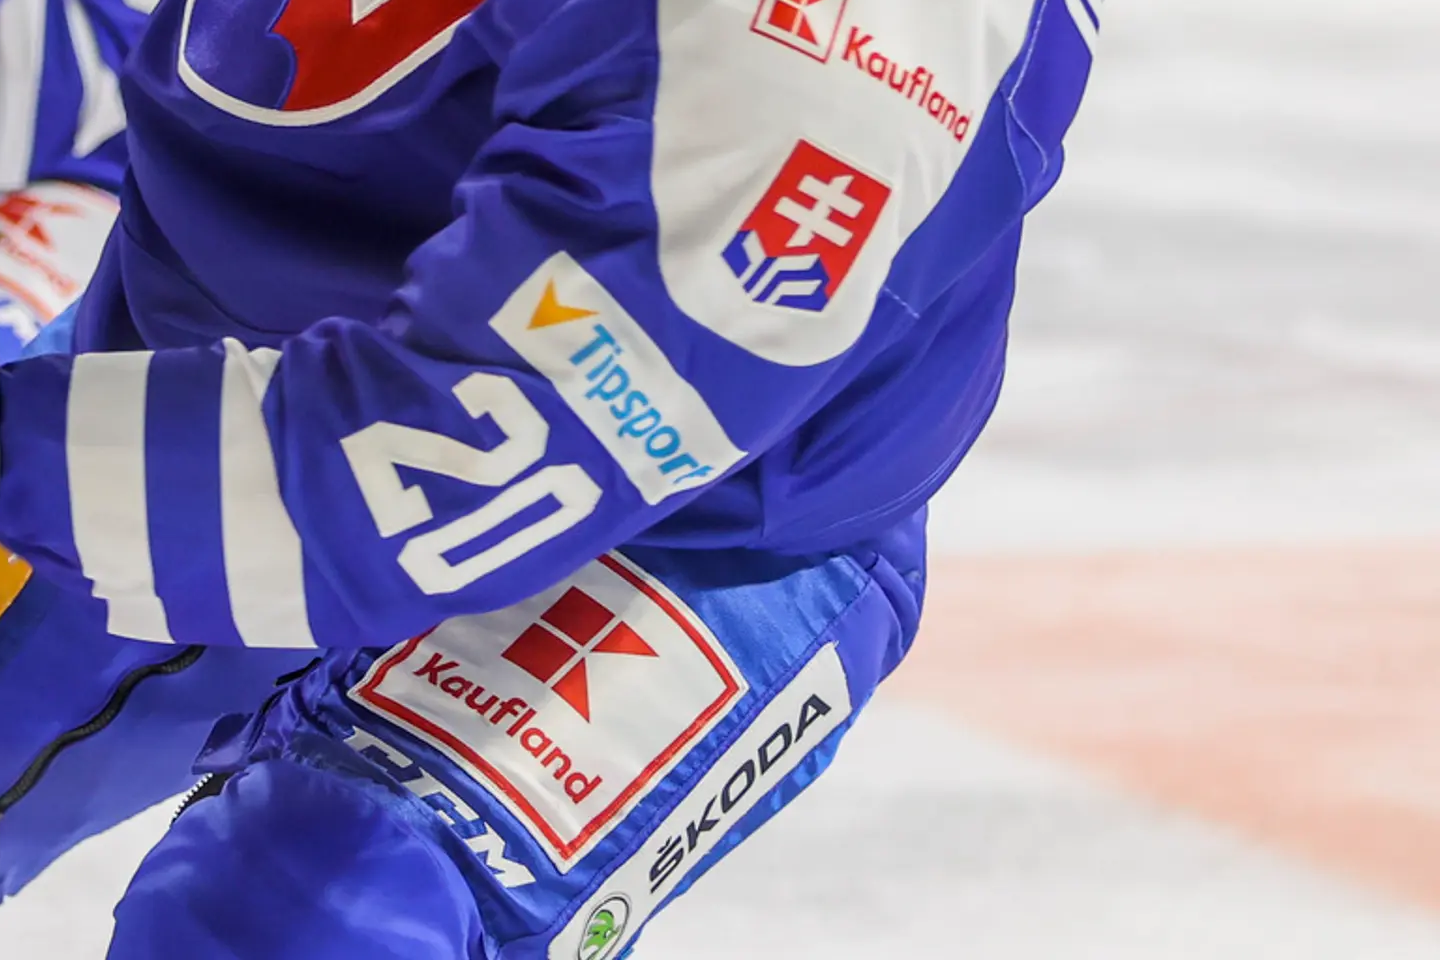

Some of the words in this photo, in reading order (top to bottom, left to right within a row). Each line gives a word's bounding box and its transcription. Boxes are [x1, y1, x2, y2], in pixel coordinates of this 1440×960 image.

[841, 24, 973, 144] Kaufland
[340, 371, 603, 596] 20
[567, 322, 715, 485] Tipsport
[413, 651, 603, 805] Kaufland
[647, 693, 833, 895] ŠKODA
